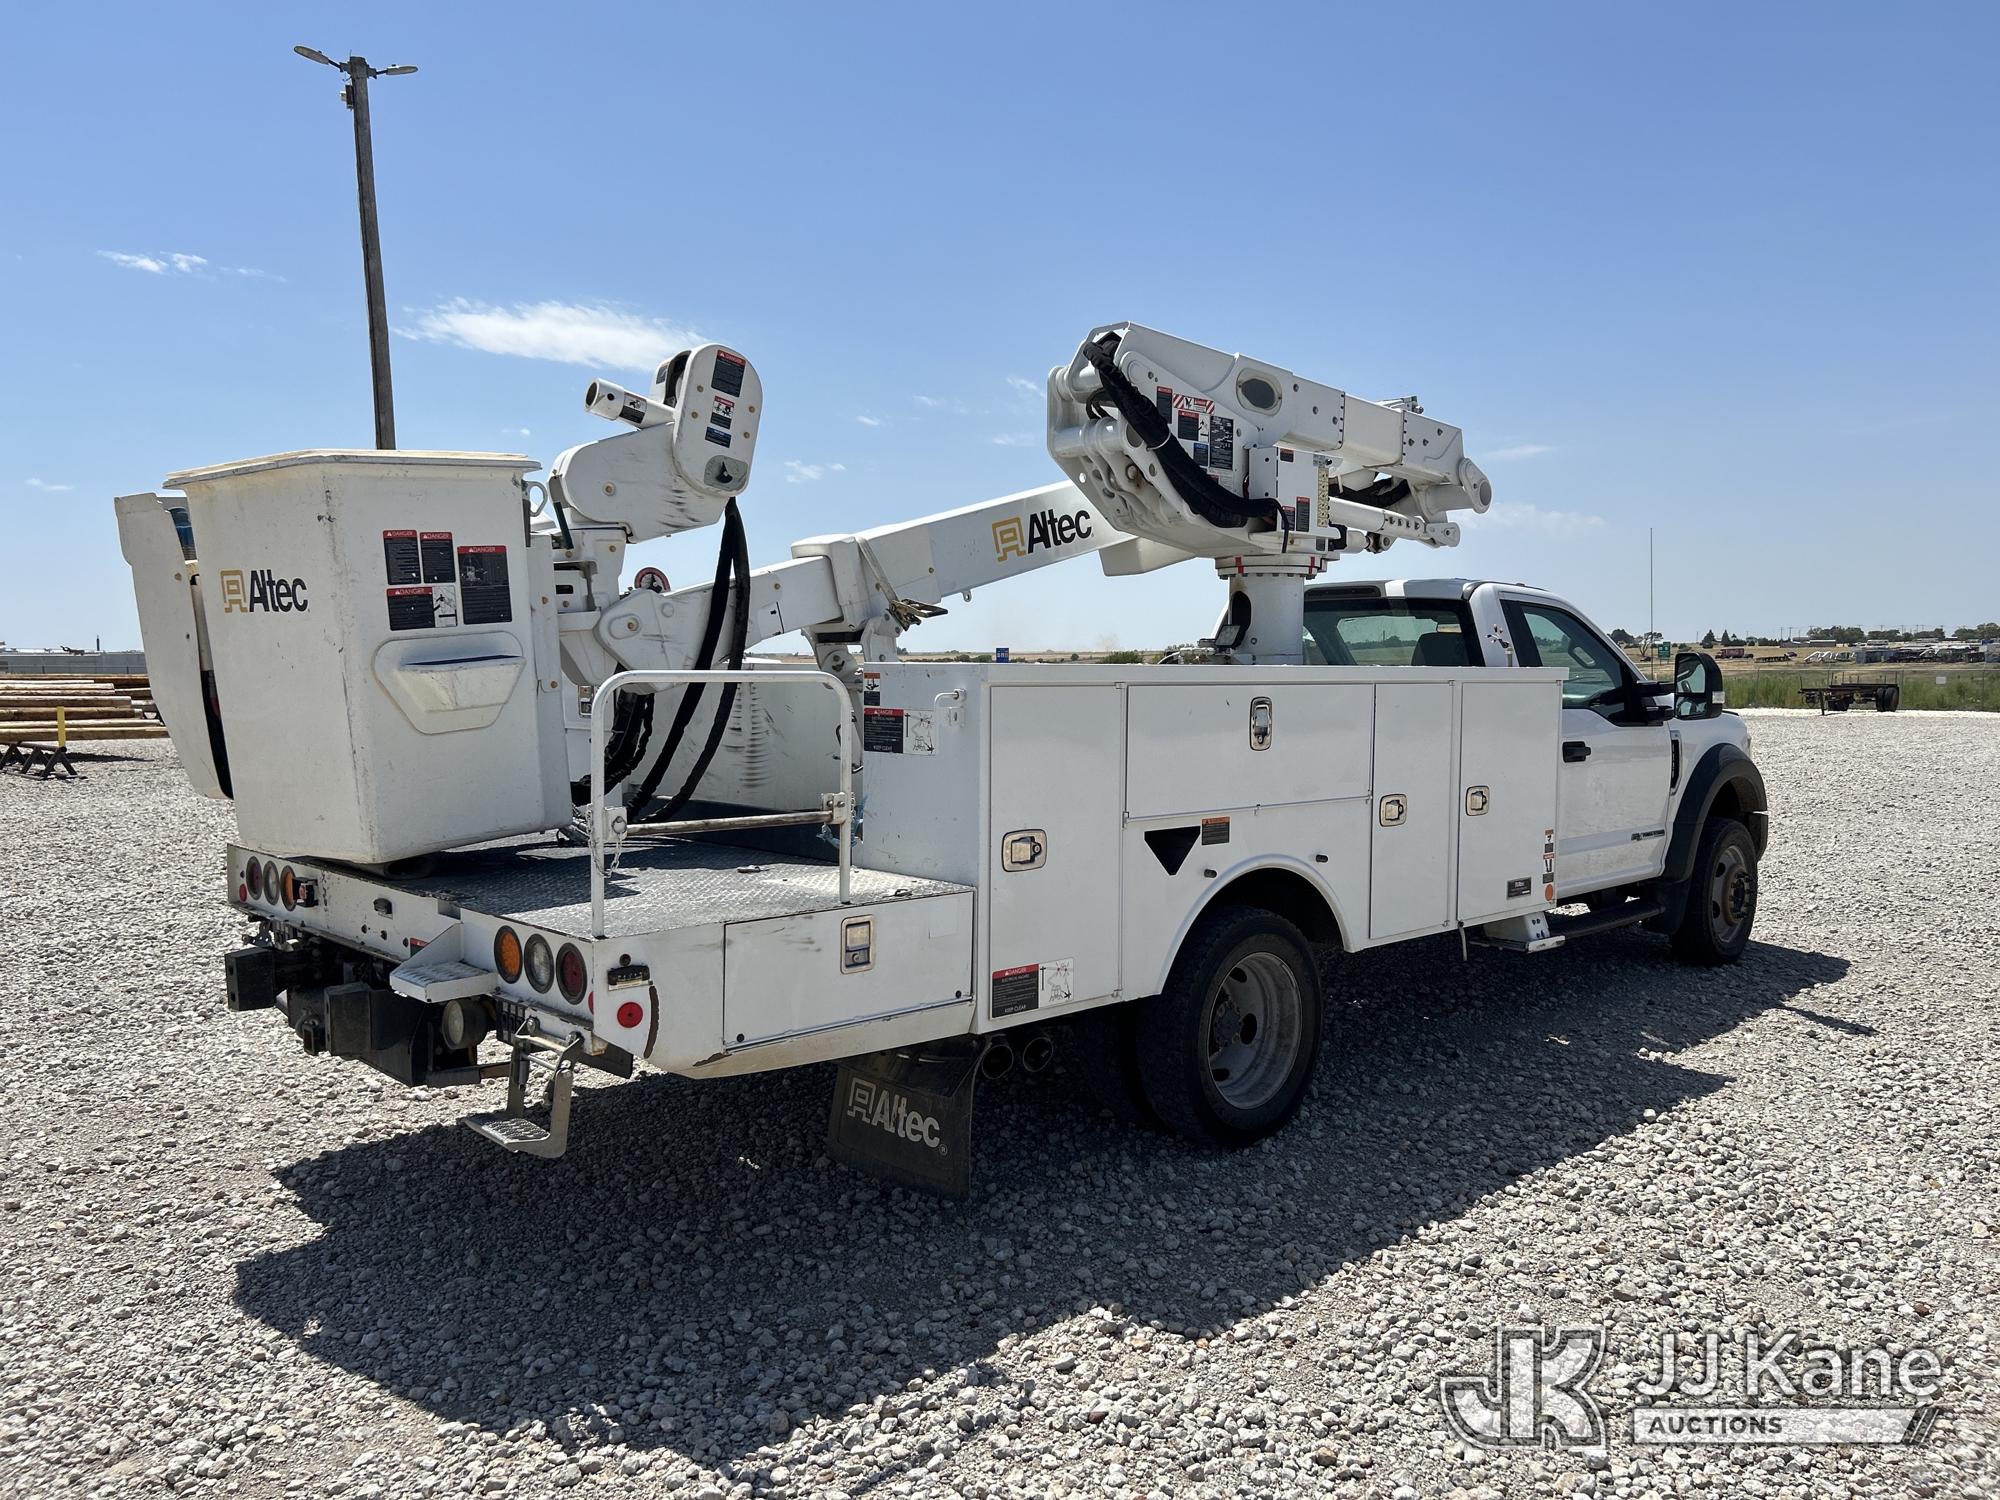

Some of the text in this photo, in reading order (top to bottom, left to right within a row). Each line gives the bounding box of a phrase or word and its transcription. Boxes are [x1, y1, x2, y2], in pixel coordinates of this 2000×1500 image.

[1028, 509, 1092, 554] Altec
[249, 569, 309, 612] Altec
[1008, 967, 1027, 976] DANGER
[871, 1089, 940, 1148] Altec
